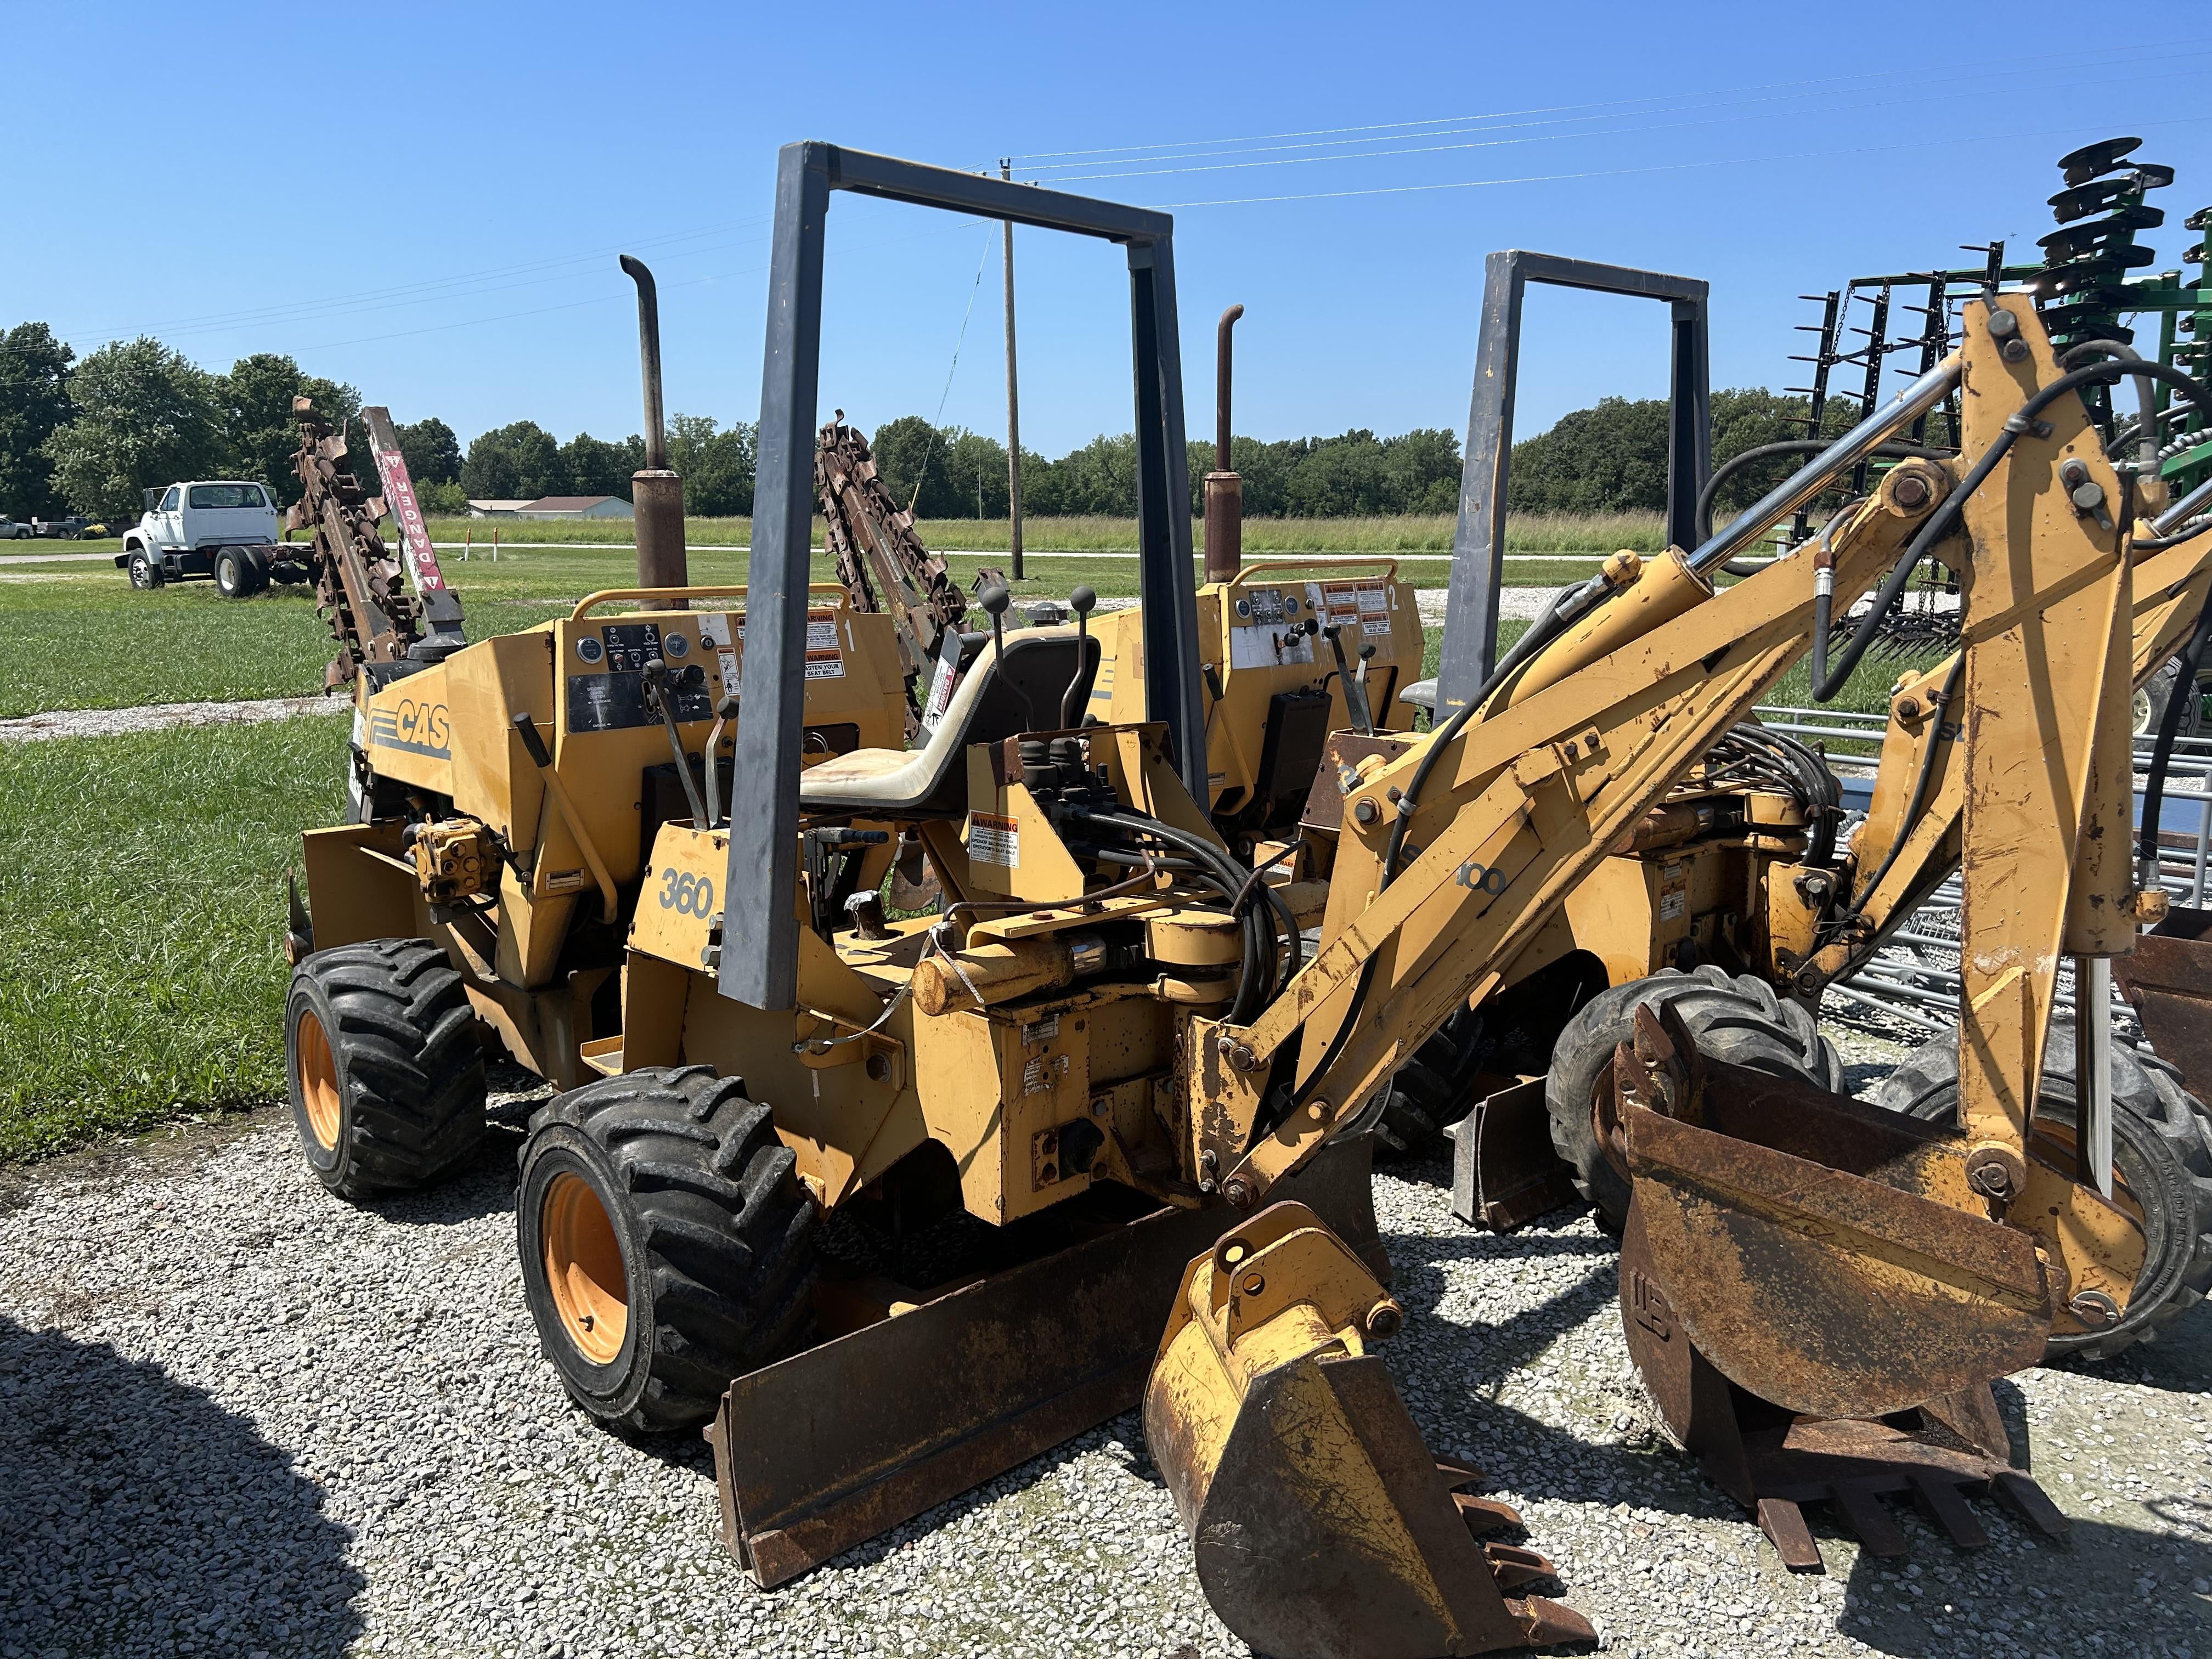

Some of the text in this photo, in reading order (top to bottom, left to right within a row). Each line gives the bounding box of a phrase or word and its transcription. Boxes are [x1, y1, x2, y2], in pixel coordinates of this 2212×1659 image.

[396, 482, 432, 563] DANGER
[1389, 584, 1398, 610] 2
[845, 619, 855, 652] 1
[807, 653, 839, 662] WARNING
[938, 679, 950, 711] DANGER
[980, 819, 1018, 833] WARNING
[973, 844, 995, 852] OPERATOR'S
[659, 867, 714, 919] 360
